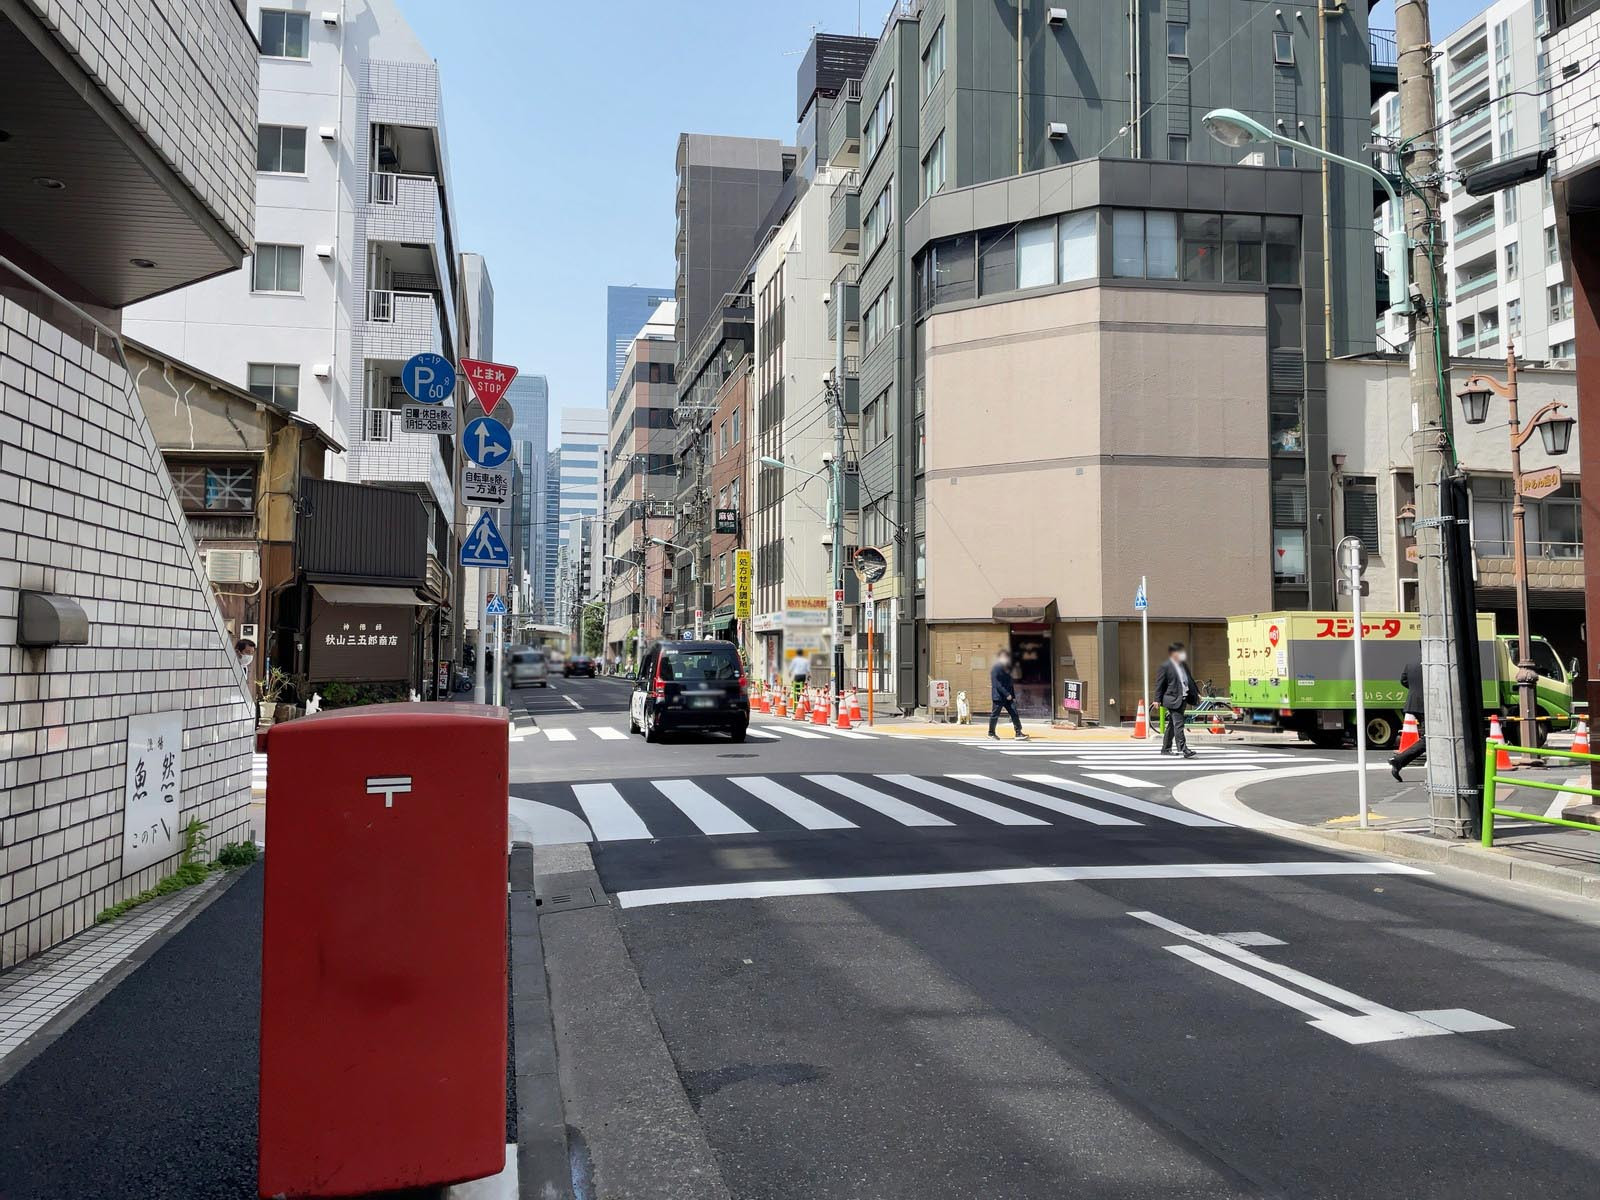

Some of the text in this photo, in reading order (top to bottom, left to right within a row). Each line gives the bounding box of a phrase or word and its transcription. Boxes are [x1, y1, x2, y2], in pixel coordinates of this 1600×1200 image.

[418, 356, 440, 365] 9-19
[472, 366, 507, 382] 止まれ
[414, 366, 435, 398] P
[478, 381, 502, 393] STOP
[465, 472, 508, 485] 自転車を除く
[465, 483, 508, 496] 一方通行
[739, 558, 748, 608] 処方せん調剤
[1316, 618, 1402, 639] スジャータ
[325, 634, 398, 646] 秋山三五郎商店
[1236, 647, 1272, 659] スジャータ
